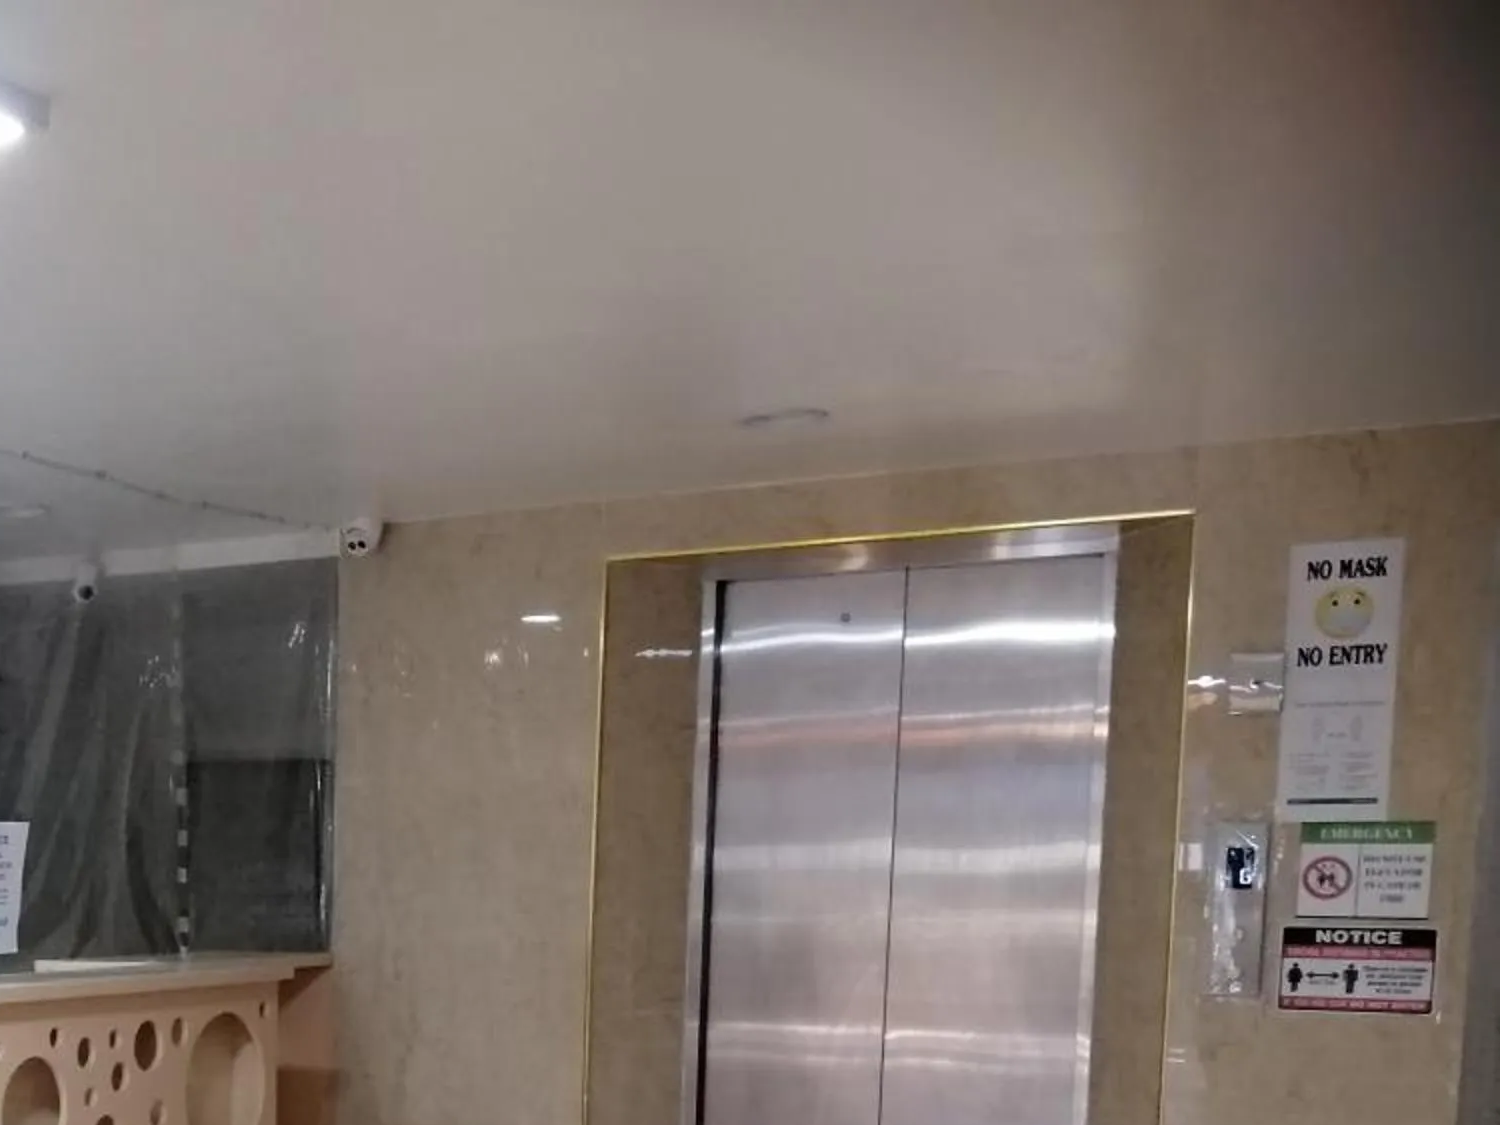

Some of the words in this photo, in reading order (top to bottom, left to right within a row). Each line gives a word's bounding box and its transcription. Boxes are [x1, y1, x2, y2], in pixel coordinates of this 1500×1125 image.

[1307, 560, 1333, 580] NO
[1339, 556, 1388, 578] MASK
[1297, 646, 1323, 667] NO
[1329, 643, 1388, 666] ENTRY
[1315, 929, 1403, 945] NOTICE
